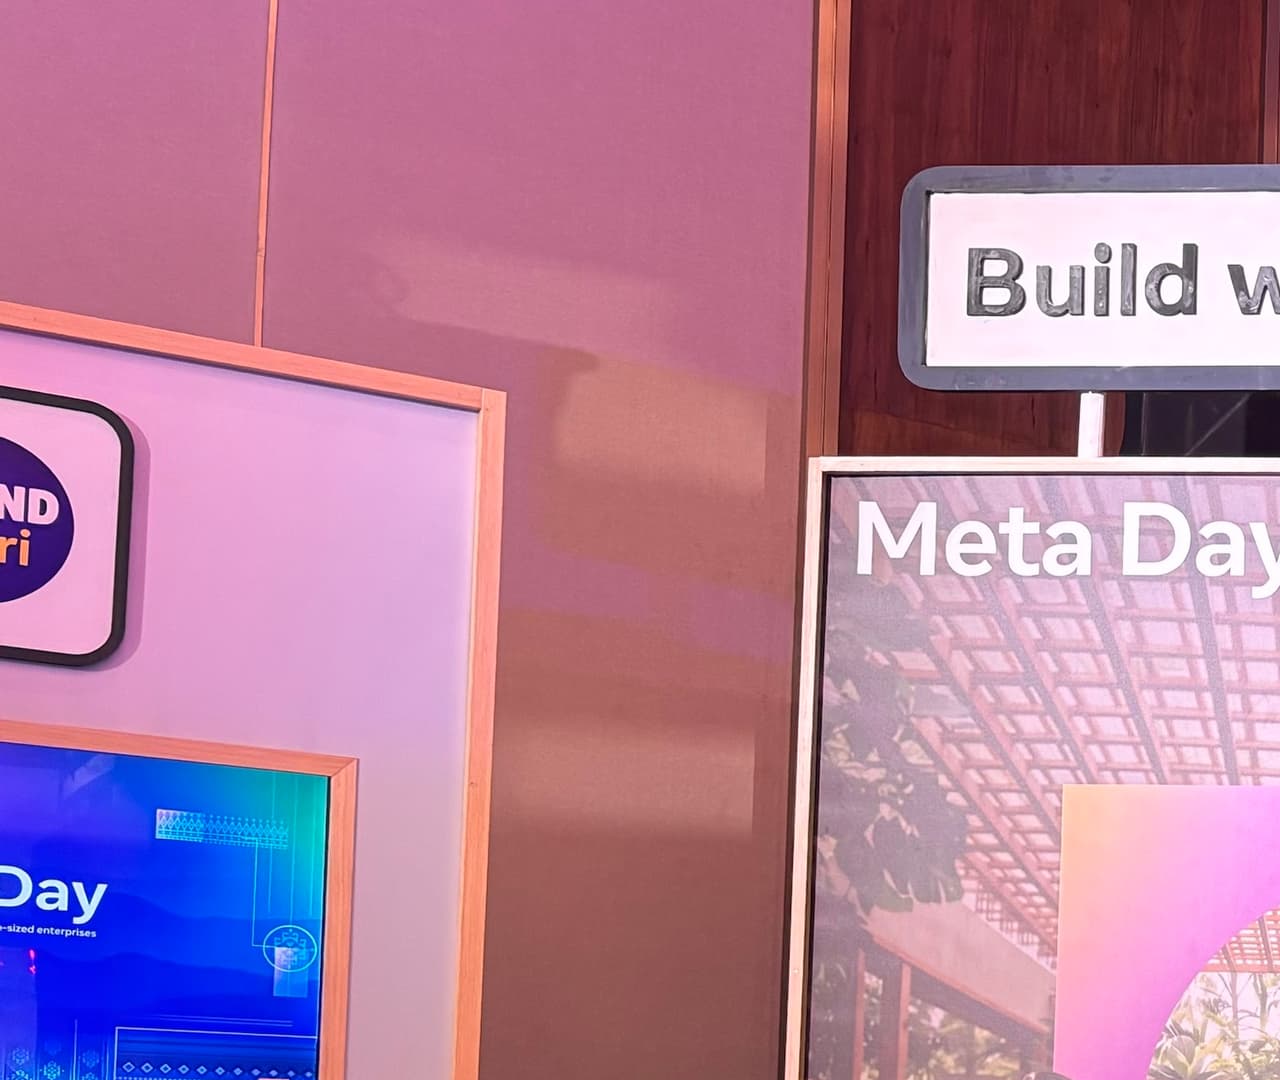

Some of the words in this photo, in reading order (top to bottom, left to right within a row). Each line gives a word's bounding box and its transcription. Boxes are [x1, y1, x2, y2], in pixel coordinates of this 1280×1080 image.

[966, 242, 1198, 317] Build
[856, 500, 1092, 577] Meta
[0, 865, 109, 925] Day
[36, 926, 97, 938] enterprises
